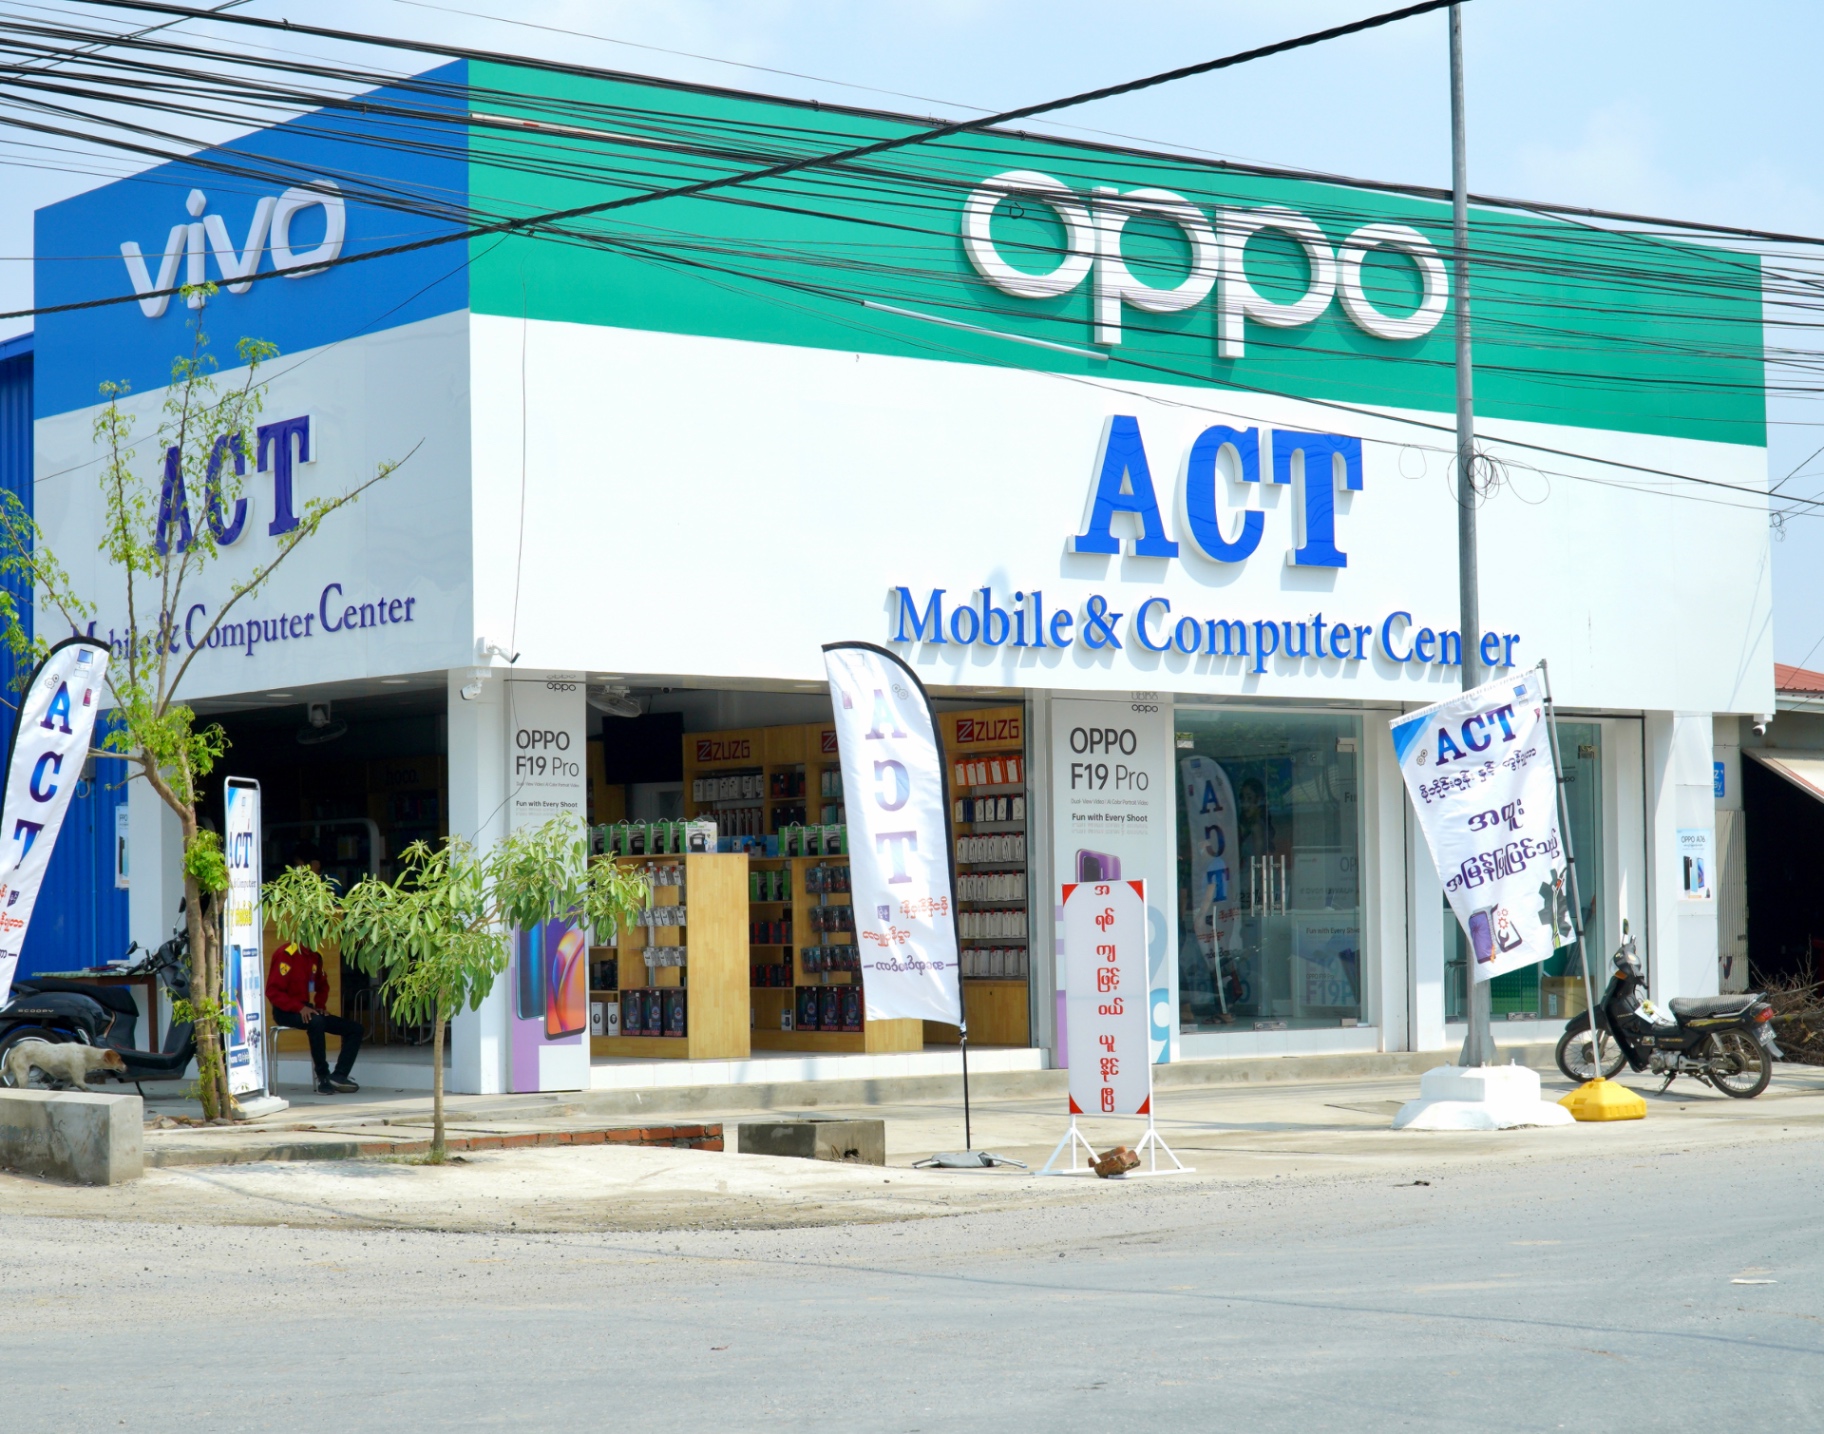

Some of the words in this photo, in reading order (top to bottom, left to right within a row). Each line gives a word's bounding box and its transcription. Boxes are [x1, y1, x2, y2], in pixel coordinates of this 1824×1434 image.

[120, 179, 346, 317] vivo
[962, 170, 1449, 358] oppo
[153, 414, 316, 556] ACT
[1068, 414, 1363, 568] ACT
[185, 603, 314, 656] Computer
[319, 583, 415, 633] Center
[888, 587, 1073, 648] Mobile
[1081, 594, 1124, 651] &
[1132, 596, 1373, 674] Computer
[1375, 611, 1521, 668] Cener
[547, 682, 577, 692] oppo
[1131, 704, 1158, 714] oppo
[516, 729, 570, 751] OPPO
[1070, 727, 1137, 755] OPPO
[1435, 704, 1516, 766] ACT
[516, 755, 547, 776] F19
[552, 756, 580, 777] Pro
[1071, 763, 1109, 790] F19
[1115, 764, 1149, 791] Pro
[1072, 813, 1086, 821] Fun
[1087, 813, 1103, 821] with
[1105, 813, 1125, 823] Every
[1126, 814, 1148, 822] Shoot
[1467, 798, 1525, 832] အထူး
